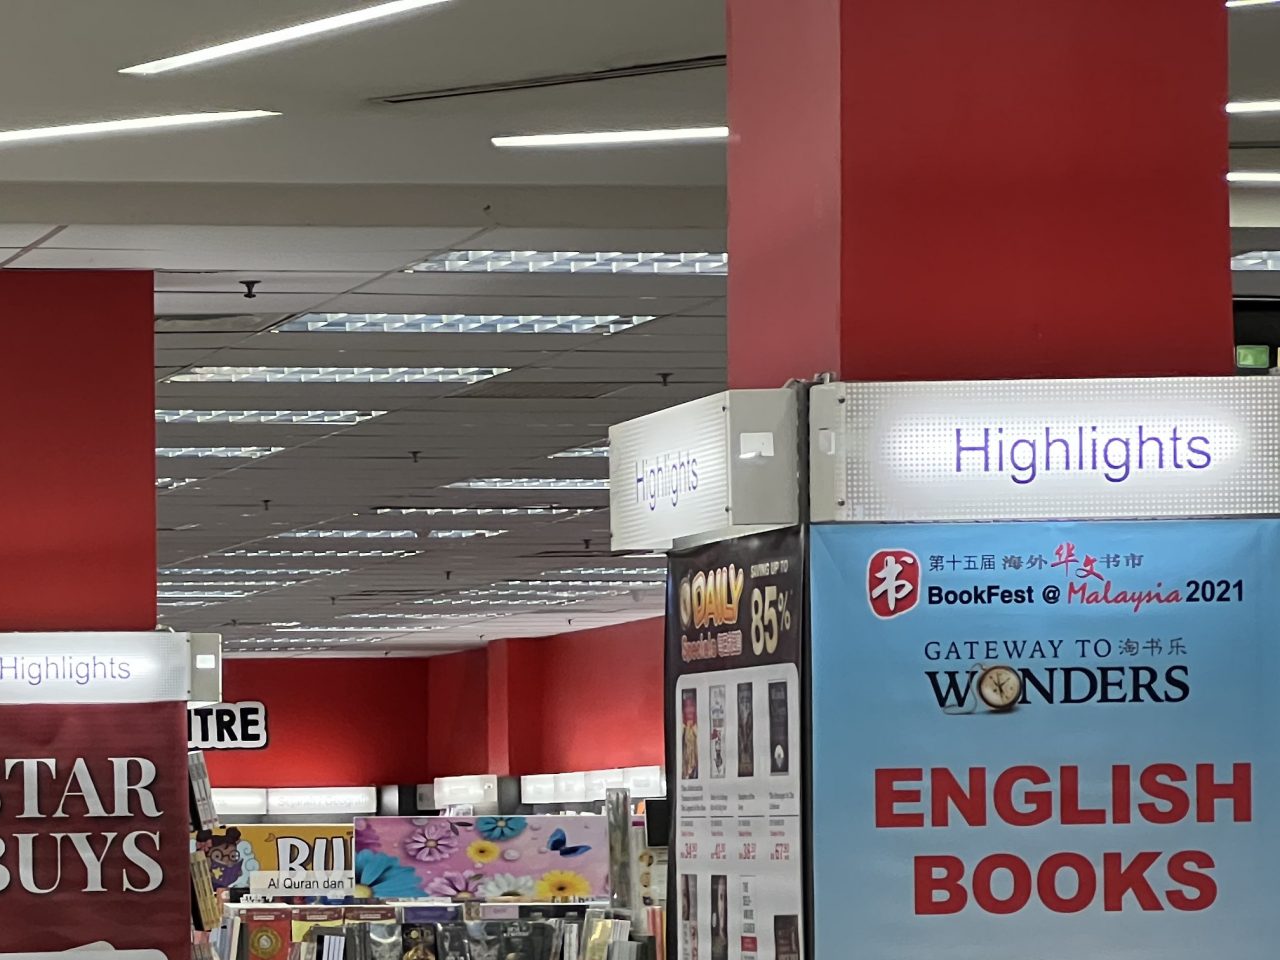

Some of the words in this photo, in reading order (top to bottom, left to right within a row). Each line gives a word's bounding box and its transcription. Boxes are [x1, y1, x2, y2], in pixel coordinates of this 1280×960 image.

[953, 425, 1212, 484] Highlights
[635, 453, 699, 511] Highlights
[928, 553, 996, 571] 第十五届
[1001, 541, 1144, 580] 海外华文书市
[692, 564, 744, 629] DAILY
[928, 586, 1033, 605] BookFest
[1042, 585, 1061, 605] @
[1066, 580, 1182, 612] Malaysia
[1185, 580, 1244, 602] 2021
[924, 639, 1064, 661] GATEWAY
[1075, 638, 1111, 658] TO
[1118, 636, 1188, 657] 淘书乐
[0, 655, 131, 686] Highlights
[924, 664, 1190, 709] WONDERS
[875, 763, 1252, 828] ENGLISH
[267, 878, 279, 889] Al
[283, 877, 319, 889] Quran
[322, 877, 342, 889] dan
[914, 850, 1218, 915] BOOKS
